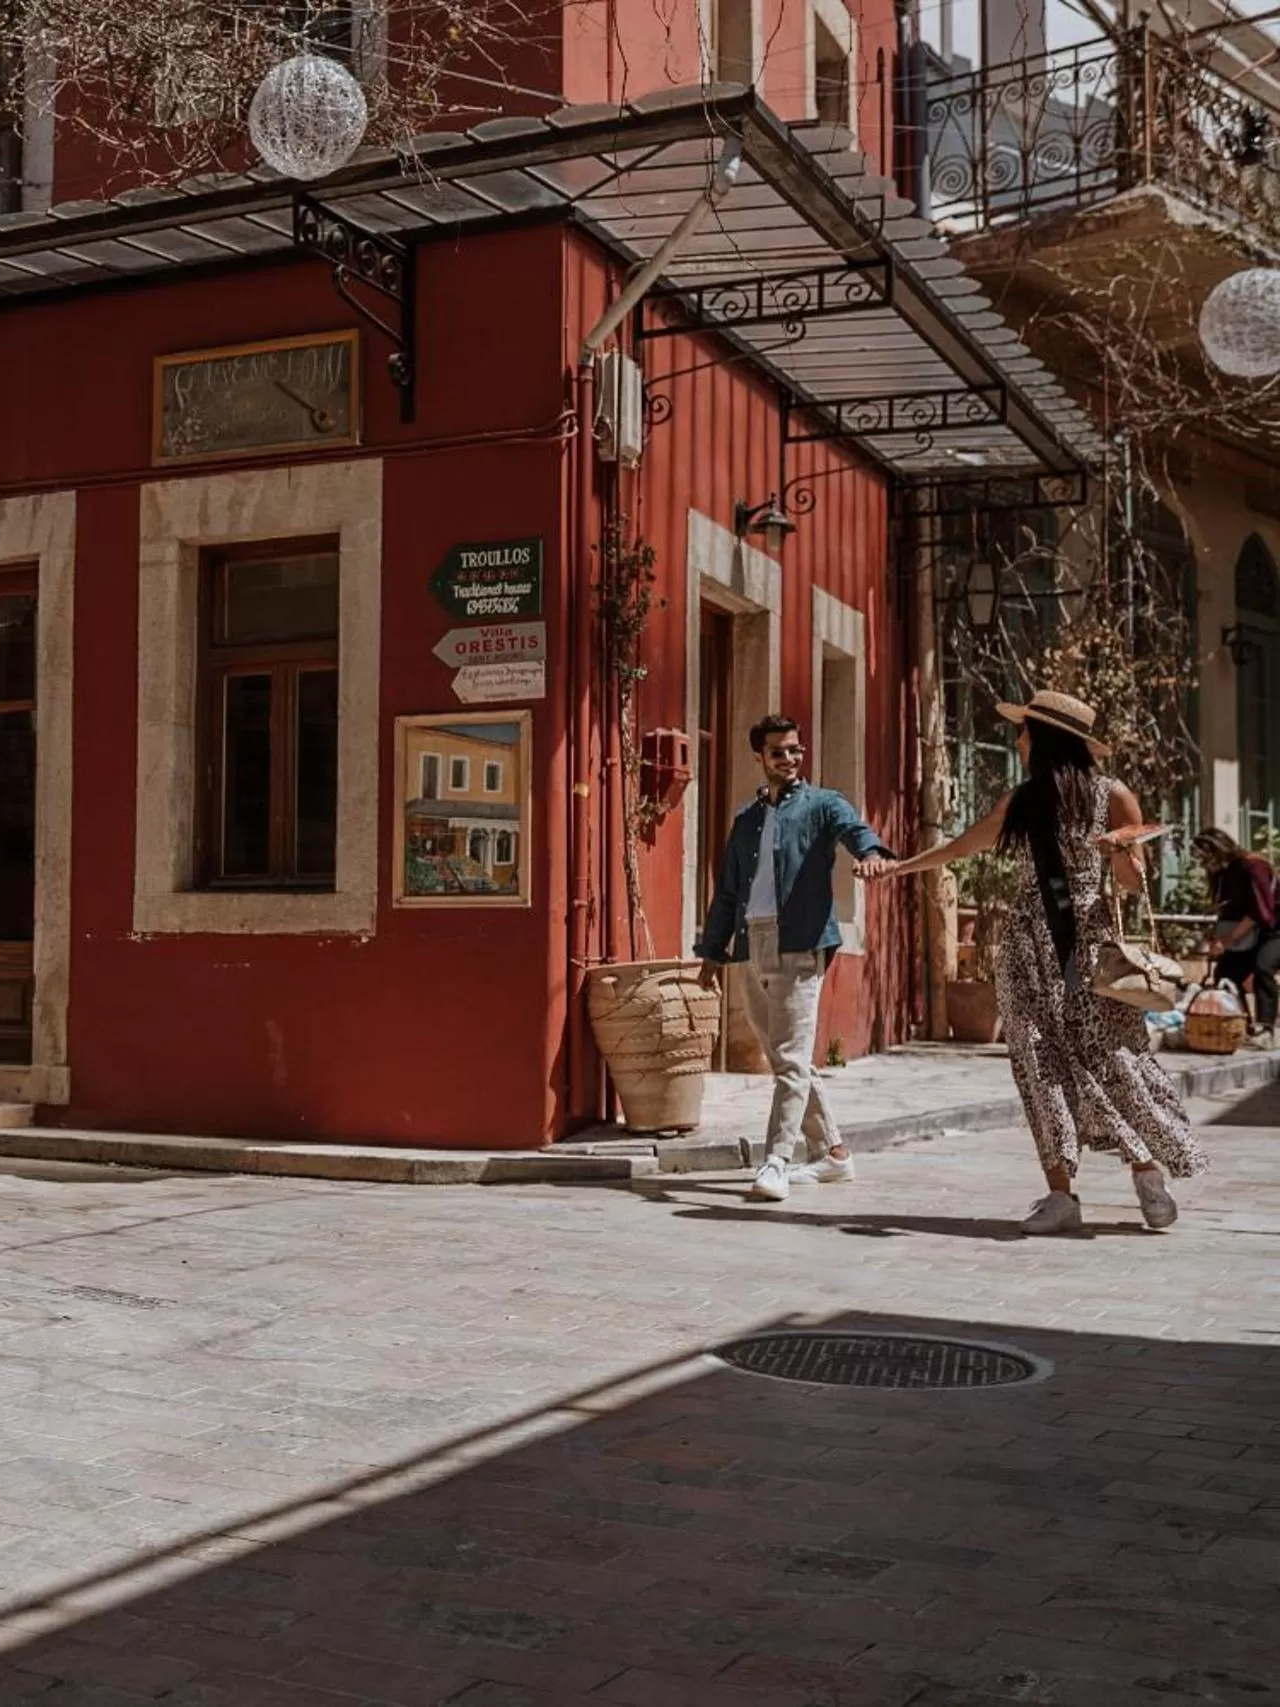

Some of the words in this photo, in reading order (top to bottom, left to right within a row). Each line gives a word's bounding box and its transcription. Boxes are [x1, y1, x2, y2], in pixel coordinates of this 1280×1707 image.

[460, 547, 530, 568] TROULLOS
[480, 626, 514, 638] Villa
[455, 635, 539, 655] ORESTIS
